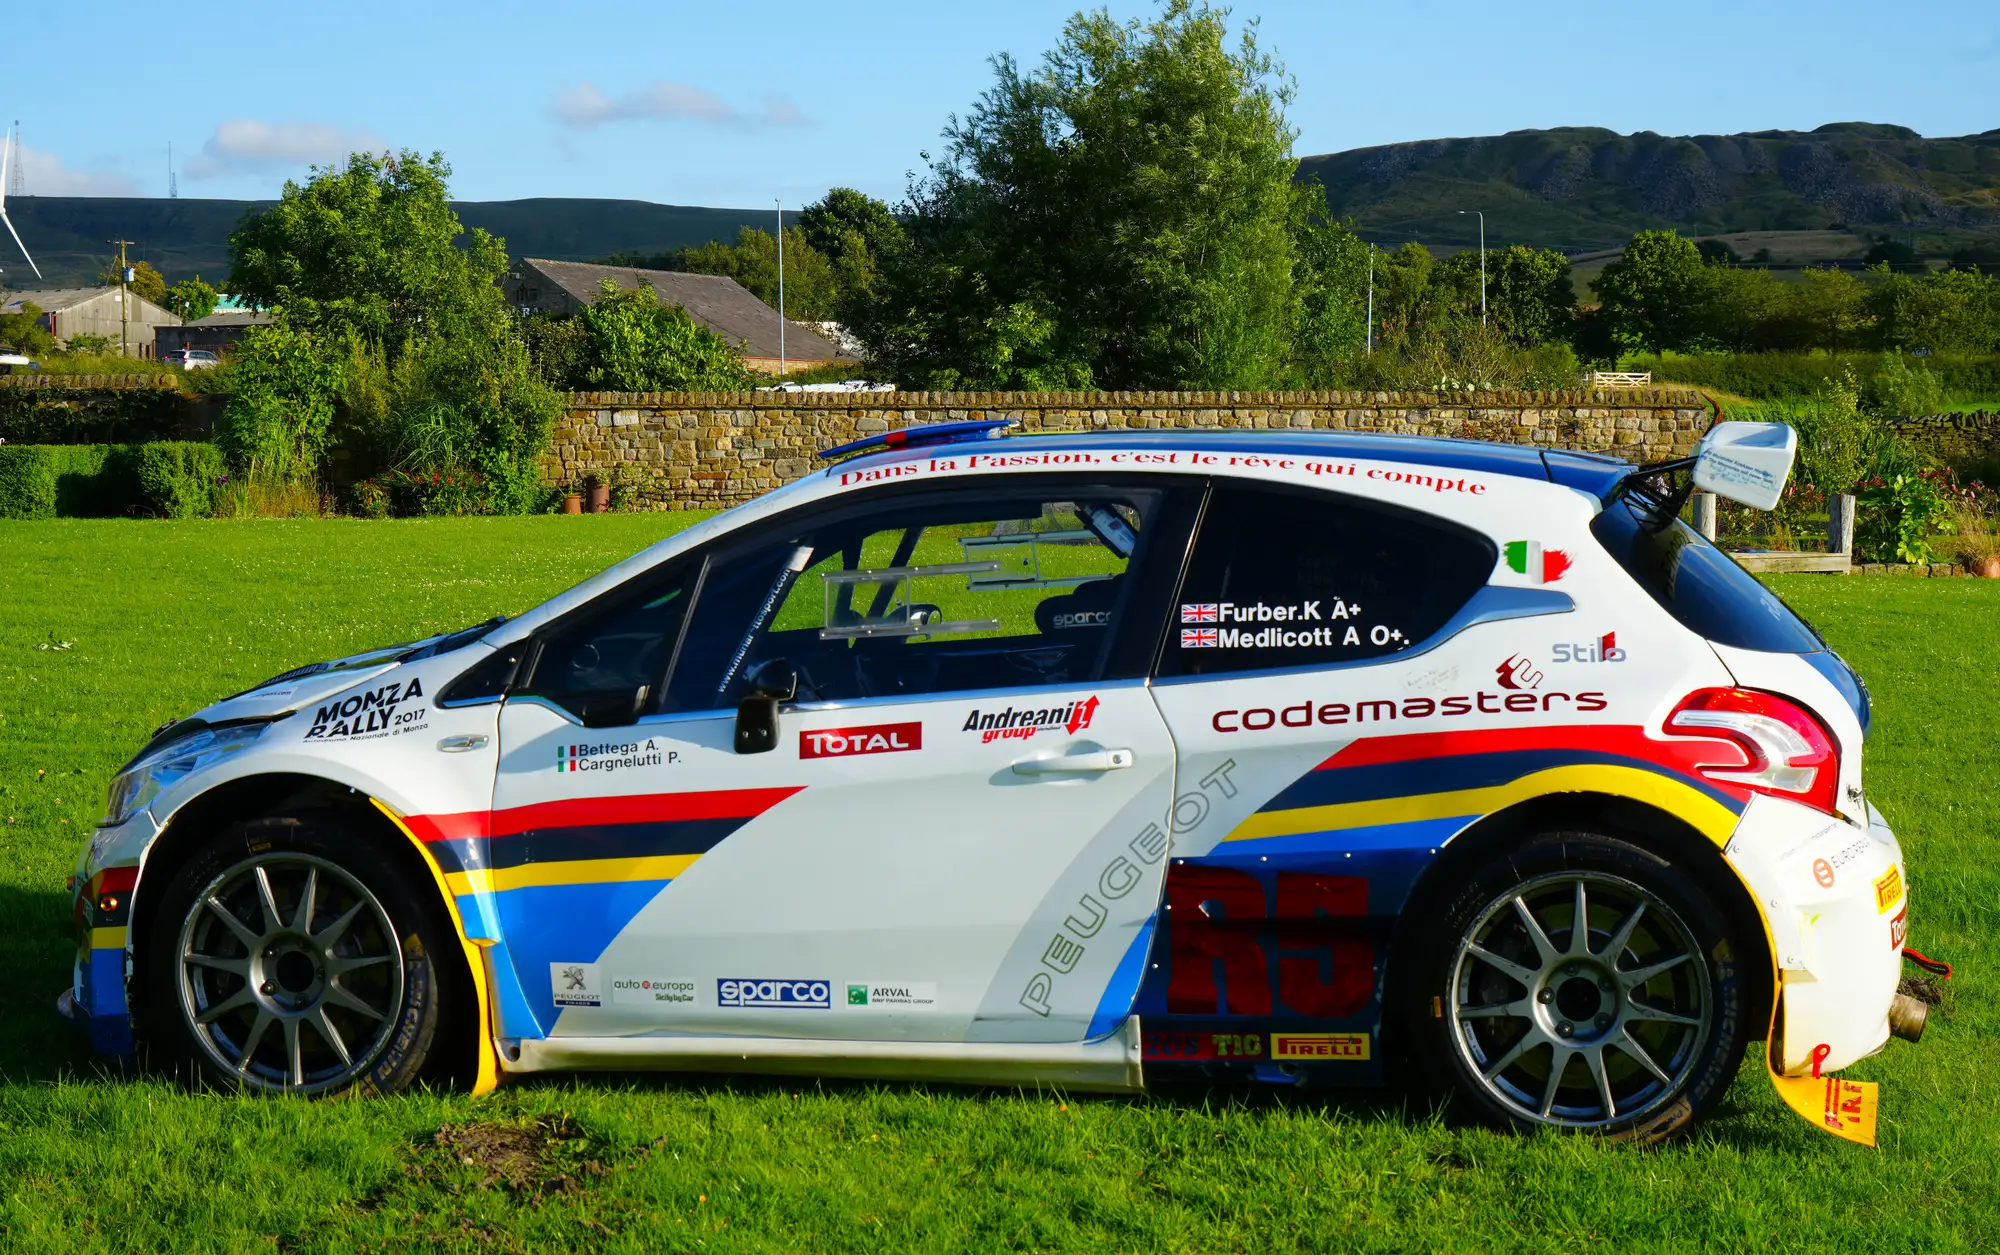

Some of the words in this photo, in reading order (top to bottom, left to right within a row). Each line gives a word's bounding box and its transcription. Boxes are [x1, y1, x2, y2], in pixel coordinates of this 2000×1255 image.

[838, 463, 918, 488] Dans
[927, 459, 957, 473] la
[968, 451, 1101, 469] Passion,
[1110, 451, 1179, 465] c'est
[1191, 452, 1218, 466] le
[1228, 455, 1295, 470] rêve
[1305, 461, 1355, 476] qui
[1366, 467, 1487, 496] compte
[1219, 600, 1322, 622] Furber.K
[1218, 627, 1332, 648] Medlicott
[1342, 625, 1361, 646] A
[1551, 635, 1627, 663] Stilo
[313, 677, 424, 726] MONZA
[1211, 690, 1608, 733] codemasters
[303, 704, 396, 739] RALLY
[394, 708, 427, 727] 2017
[961, 701, 1075, 732] Andreani
[349, 732, 389, 741] Nazionale
[392, 727, 400, 736] di
[402, 722, 429, 734] Monza
[805, 731, 909, 755] TOTAL
[981, 726, 1037, 744] group
[578, 742, 638, 757] Bettega
[645, 739, 660, 751] A.
[578, 752, 662, 772] Cargnelutti
[668, 751, 682, 764] P.
[1018, 757, 1239, 1019] PEUGEOT
[1164, 863, 1376, 1019] R5
[613, 979, 641, 990] auto
[652, 981, 694, 993] europa
[720, 980, 829, 1007] sparco
[872, 987, 913, 998] ARVAL
[1277, 1037, 1363, 1056] PIRELLI
